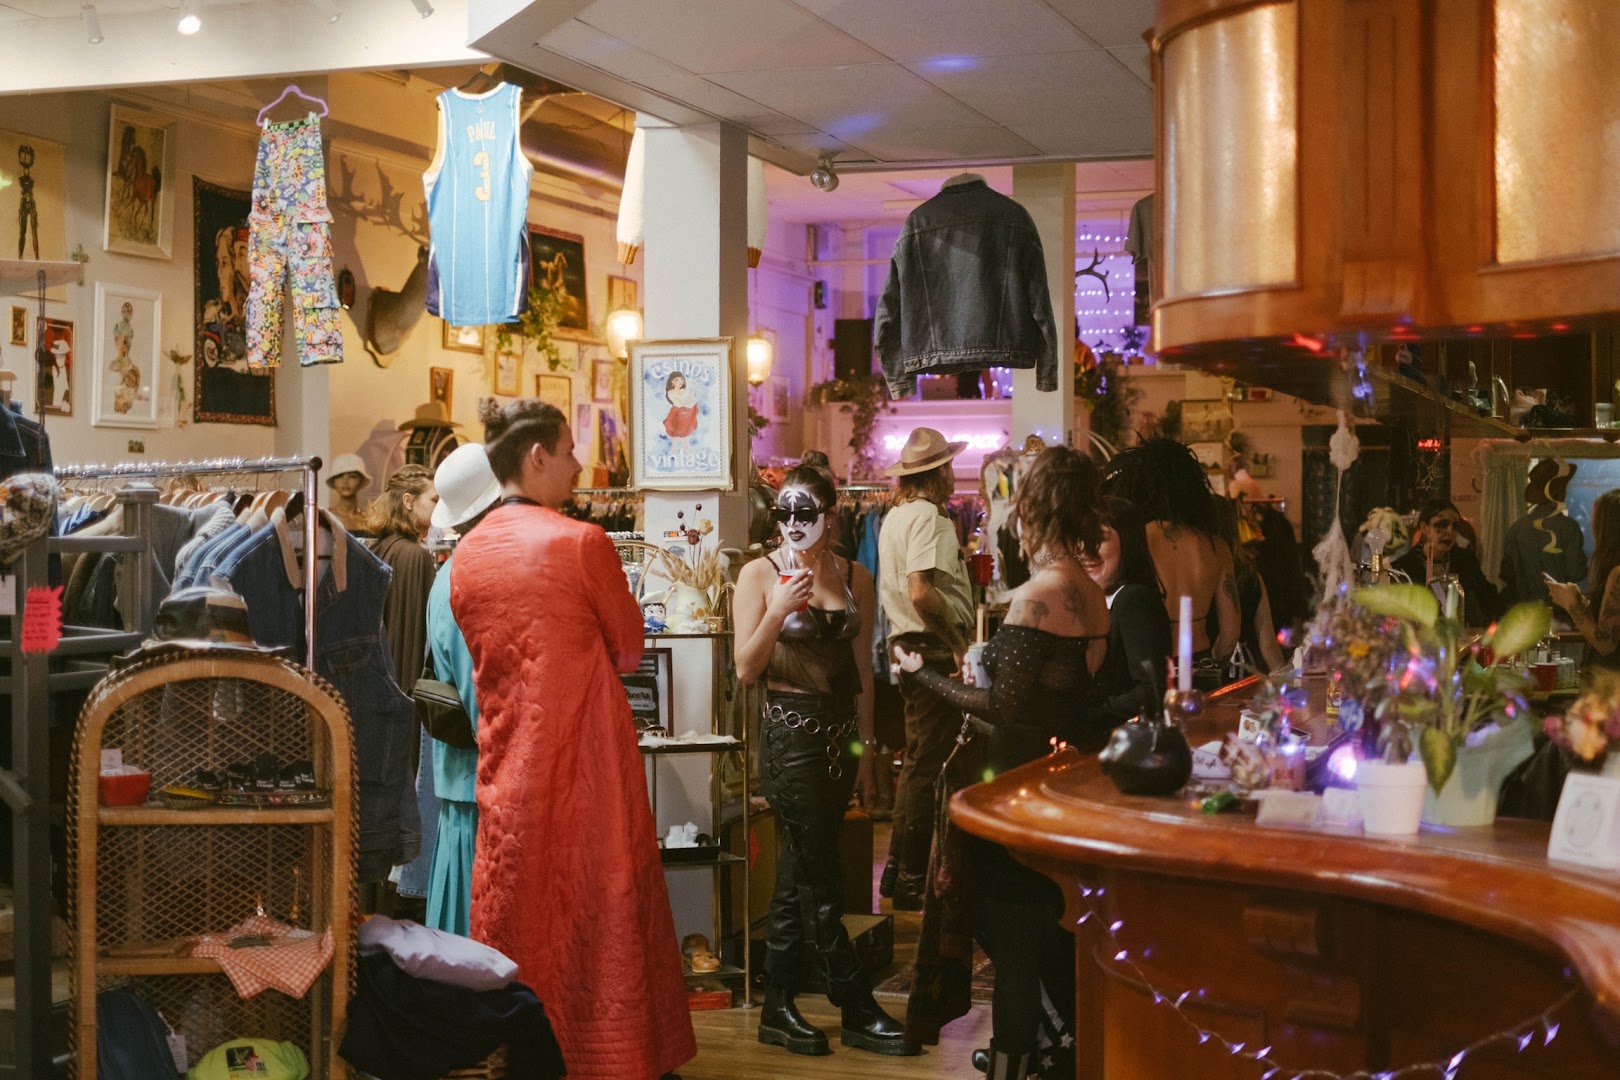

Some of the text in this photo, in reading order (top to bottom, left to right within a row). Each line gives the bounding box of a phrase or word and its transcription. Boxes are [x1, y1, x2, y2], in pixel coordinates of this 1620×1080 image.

[466, 121, 495, 143] PAUL
[473, 151, 491, 201] 3
[647, 448, 719, 471] vintage
